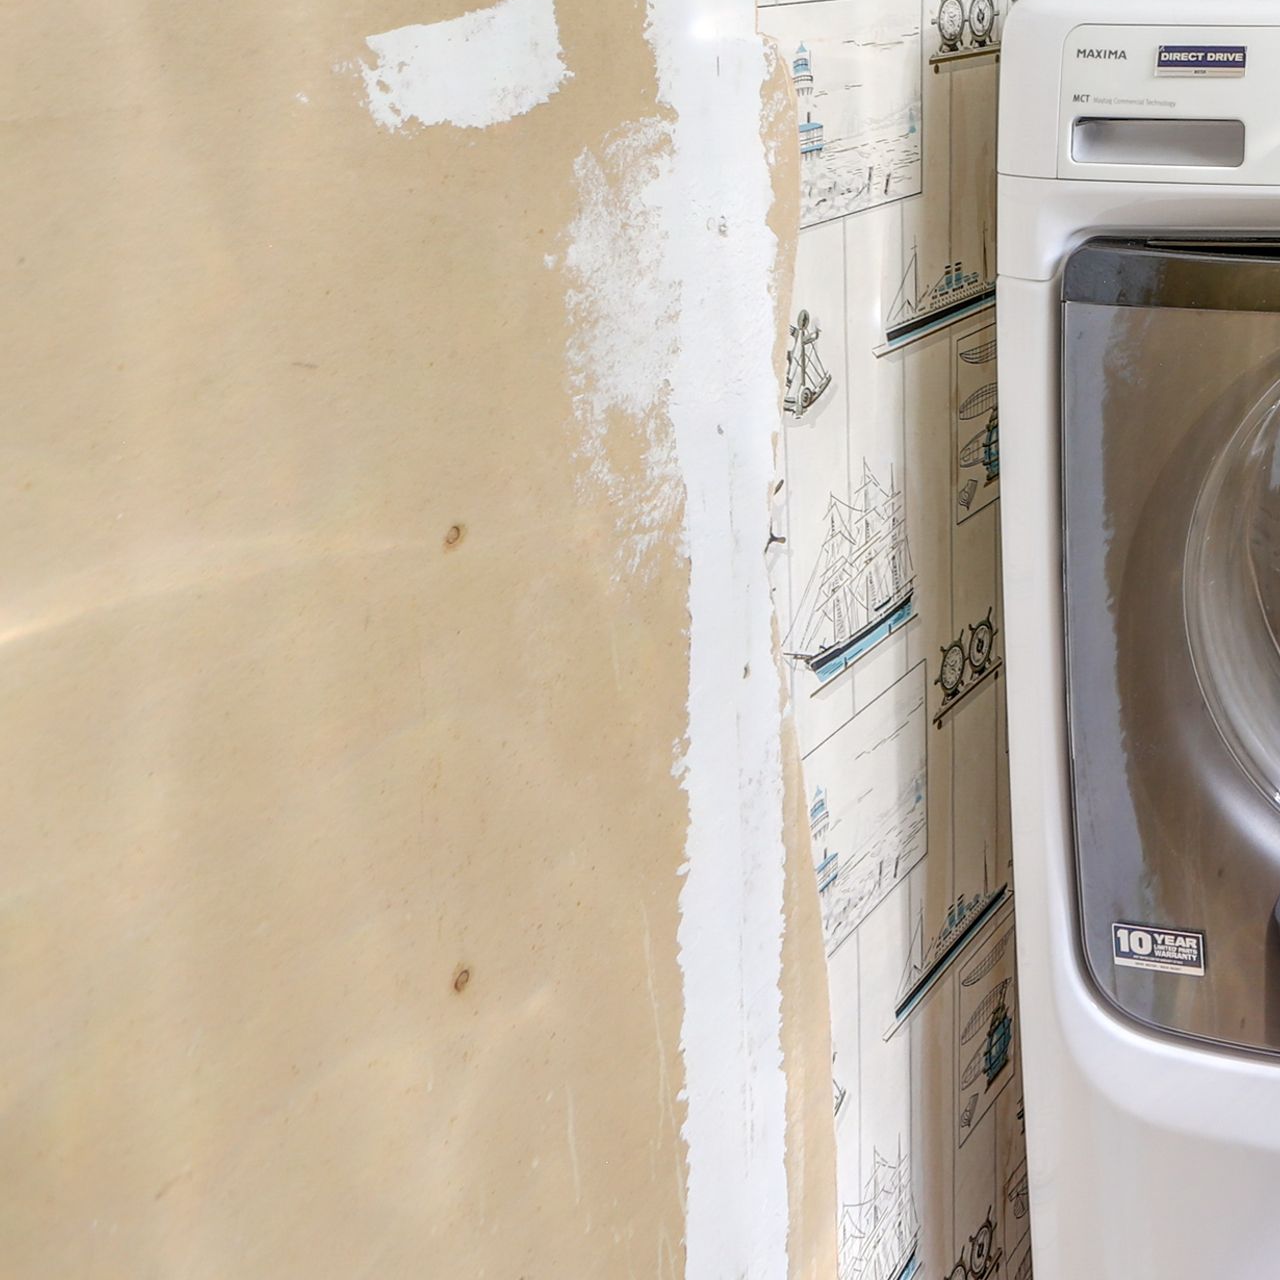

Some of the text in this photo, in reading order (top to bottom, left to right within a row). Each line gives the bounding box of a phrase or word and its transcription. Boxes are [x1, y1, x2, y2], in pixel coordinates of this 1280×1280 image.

[1076, 49, 1127, 60] MAXIMA
[1160, 52, 1244, 62] DIRECT DRIVE
[1072, 94, 1090, 103] MCT
[1117, 928, 1197, 955] 10 YEAR
[1154, 950, 1197, 961] WARRANTY
